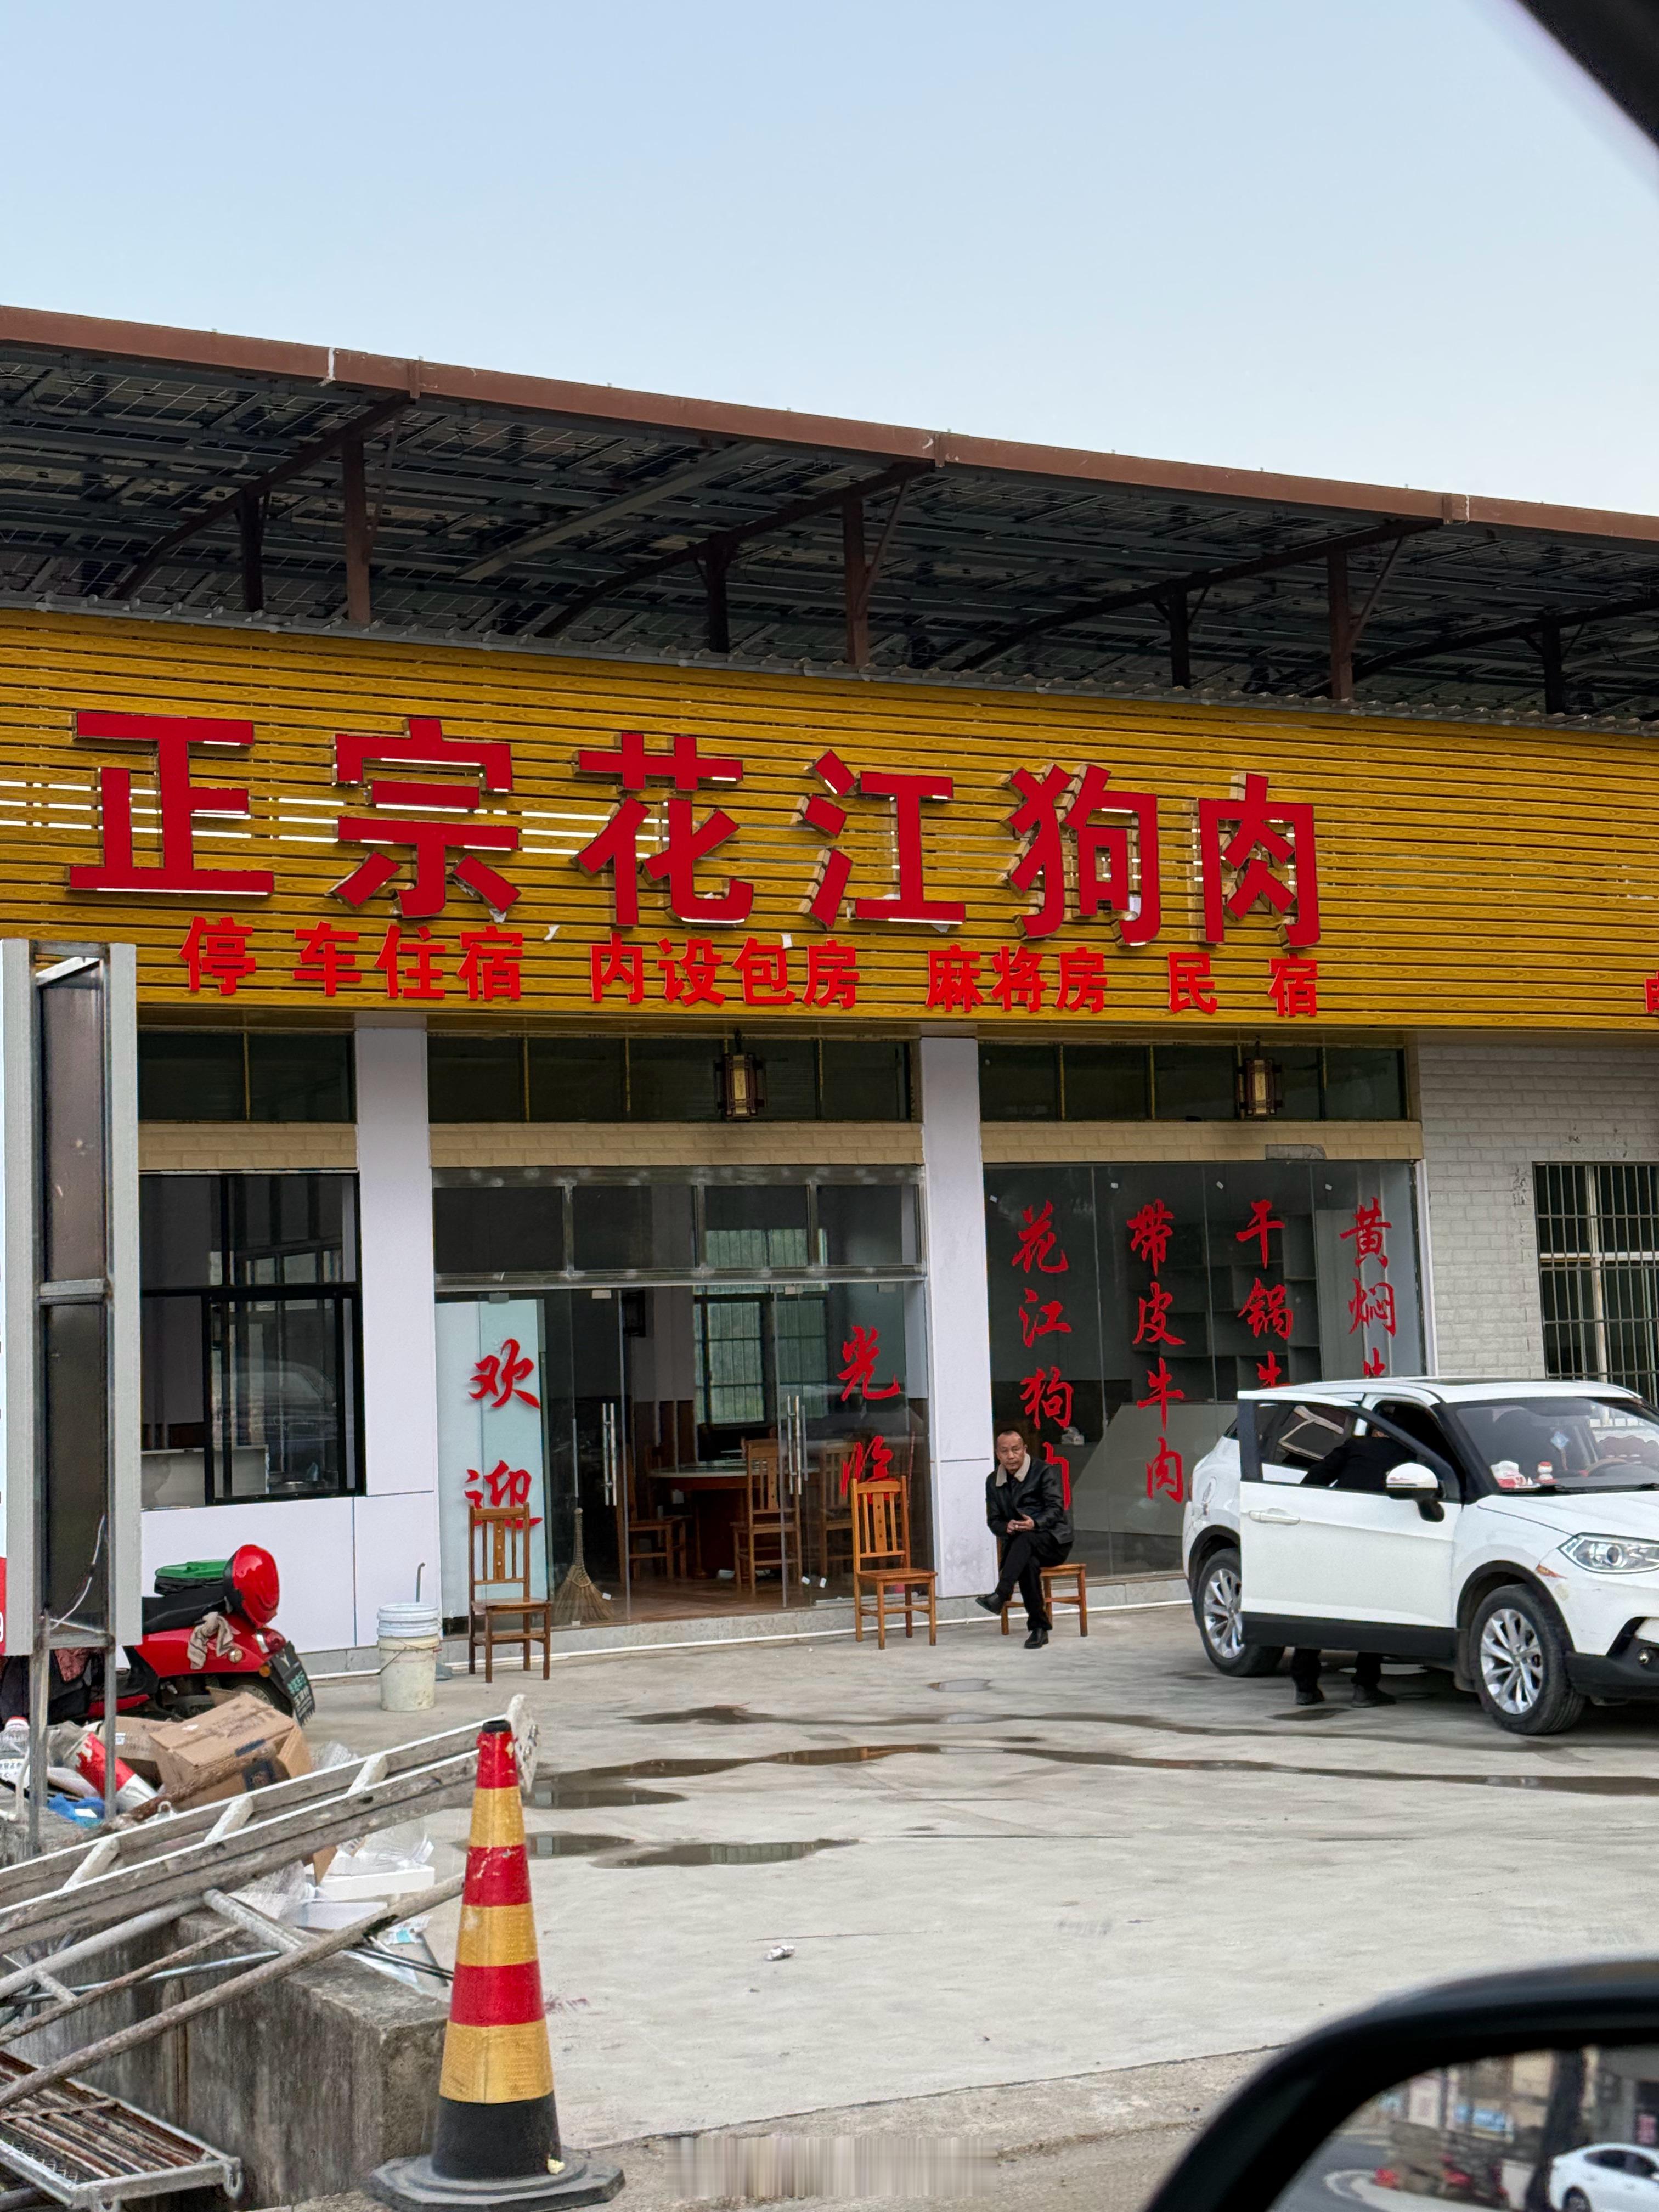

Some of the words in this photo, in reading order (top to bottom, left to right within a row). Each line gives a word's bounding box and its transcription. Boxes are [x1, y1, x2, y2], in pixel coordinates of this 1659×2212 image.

[69, 711, 1321, 948] 正宗花江狗肉
[179, 916, 524, 1001] 停车住宿
[590, 932, 860, 1008] 内设包房
[926, 944, 1107, 1013] 麻将房
[1168, 952, 1318, 1017] 民宿
[465, 1338, 542, 1530] 欢迎
[1126, 1199, 1186, 1504] 带皮牛肉
